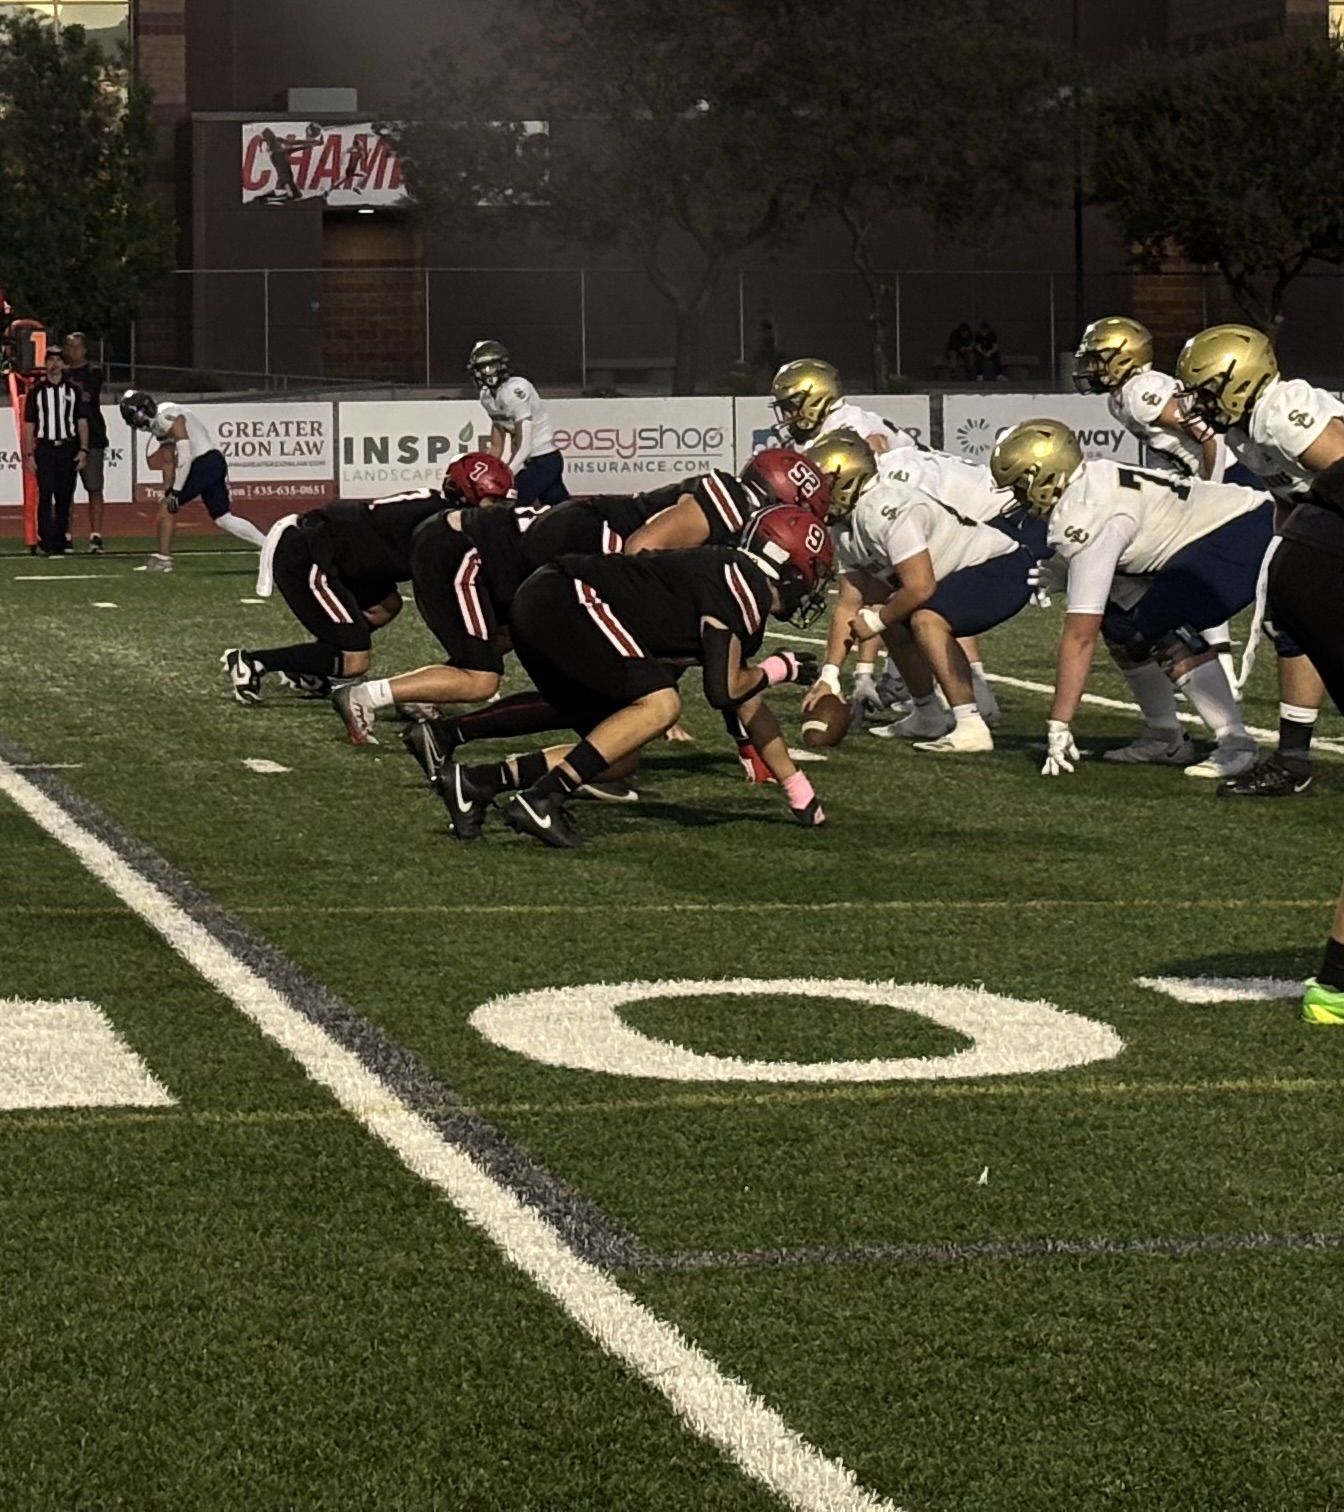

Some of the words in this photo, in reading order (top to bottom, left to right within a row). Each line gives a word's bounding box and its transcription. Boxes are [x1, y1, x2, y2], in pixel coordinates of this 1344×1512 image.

[242, 134, 402, 191] CHAM
[218, 420, 323, 438] GREATER
[219, 440, 272, 457] ZION
[279, 440, 325, 456] LAW
[552, 424, 725, 459] easyshop
[567, 460, 710, 473] INSURANCE.COM
